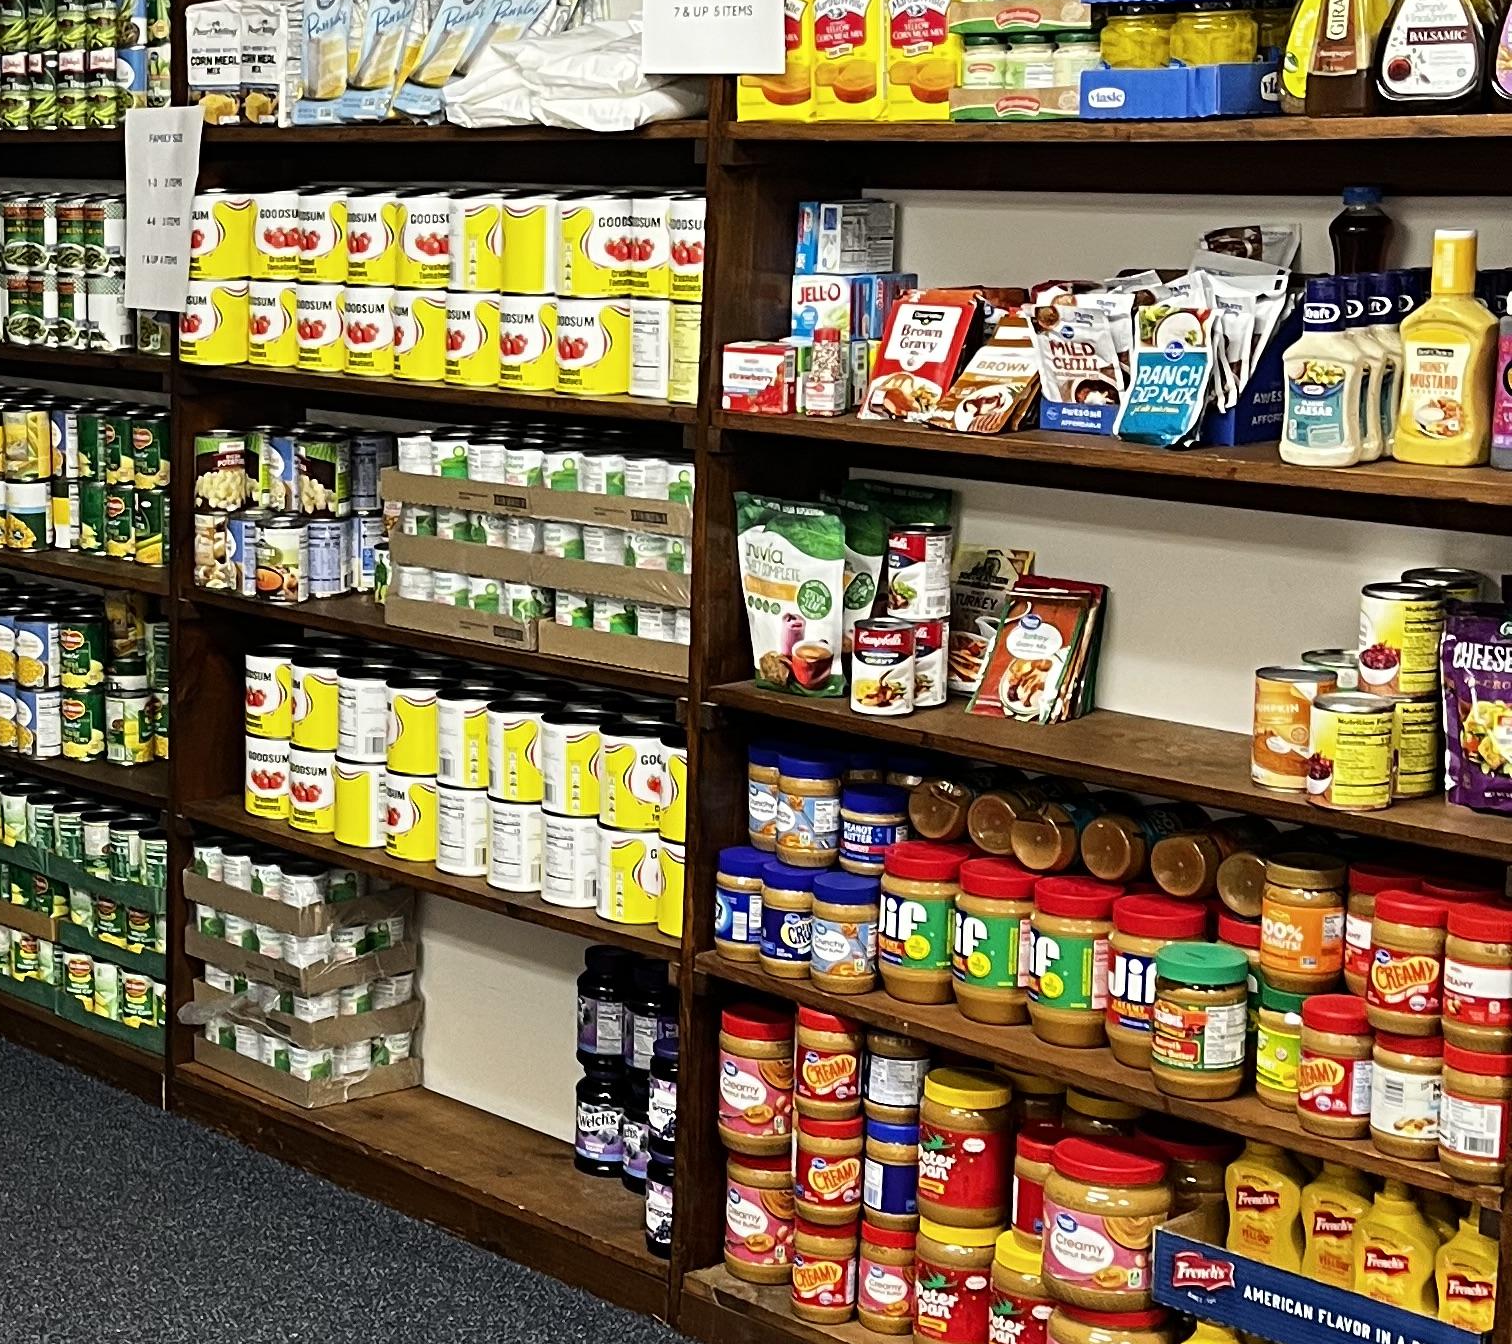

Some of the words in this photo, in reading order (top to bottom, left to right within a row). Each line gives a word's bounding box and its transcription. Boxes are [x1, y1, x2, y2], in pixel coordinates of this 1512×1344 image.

[674, 7, 680, 18] 7
[682, 7, 690, 18] &
[693, 7, 709, 18] UP
[714, 6, 720, 17] 5
[722, 6, 753, 17] ITEMS
[904, 21, 929, 31] YELLOW
[1409, 28, 1468, 43] BALSAMIC
[191, 55, 213, 66] CORN
[215, 55, 240, 66] MEAL
[1090, 90, 1123, 104] Vlasic
[797, 280, 841, 305] JELL-O
[900, 324, 944, 338] Brown
[899, 338, 938, 354] Gravy
[1050, 341, 1095, 356] MILD
[976, 360, 1030, 373] BROWN
[1053, 357, 1101, 372] CHILI
[1419, 361, 1450, 373] HONEY
[728, 373, 774, 384] strawberry
[1138, 365, 1204, 386] RANCH
[1410, 374, 1458, 391] MUSTARD
[1131, 386, 1157, 404] DIP
[1159, 388, 1198, 405] MIX
[1294, 406, 1333, 418] CAESAR
[955, 592, 999, 609] TURKEY
[859, 630, 902, 648] Campbell's
[1338, 718, 1375, 727] Nutrition
[843, 821, 873, 834] PEANUT
[843, 831, 873, 844] BUTTER
[879, 893, 928, 942] Jif
[814, 937, 846, 953] Crunchy
[1375, 957, 1439, 991] CREAMY
[805, 1057, 856, 1086] CREAMY
[722, 1075, 760, 1095] Creamy
[579, 1113, 616, 1128] Welch's
[812, 1162, 860, 1192] CREAMY
[1238, 1190, 1277, 1208] French's
[726, 1205, 761, 1225] Creamy
[1315, 1215, 1354, 1233] French's
[1055, 1233, 1105, 1255] Creamy
[1365, 1252, 1407, 1270] French's
[794, 1263, 840, 1289] CREAMY
[1175, 1261, 1227, 1282] French's
[868, 1275, 903, 1293] Creamy
[916, 1283, 959, 1308] Peter
[918, 1301, 952, 1320] Pan
[1243, 1285, 1314, 1321] AMERICAN
[1317, 1312, 1371, 1340] FLAVOR
